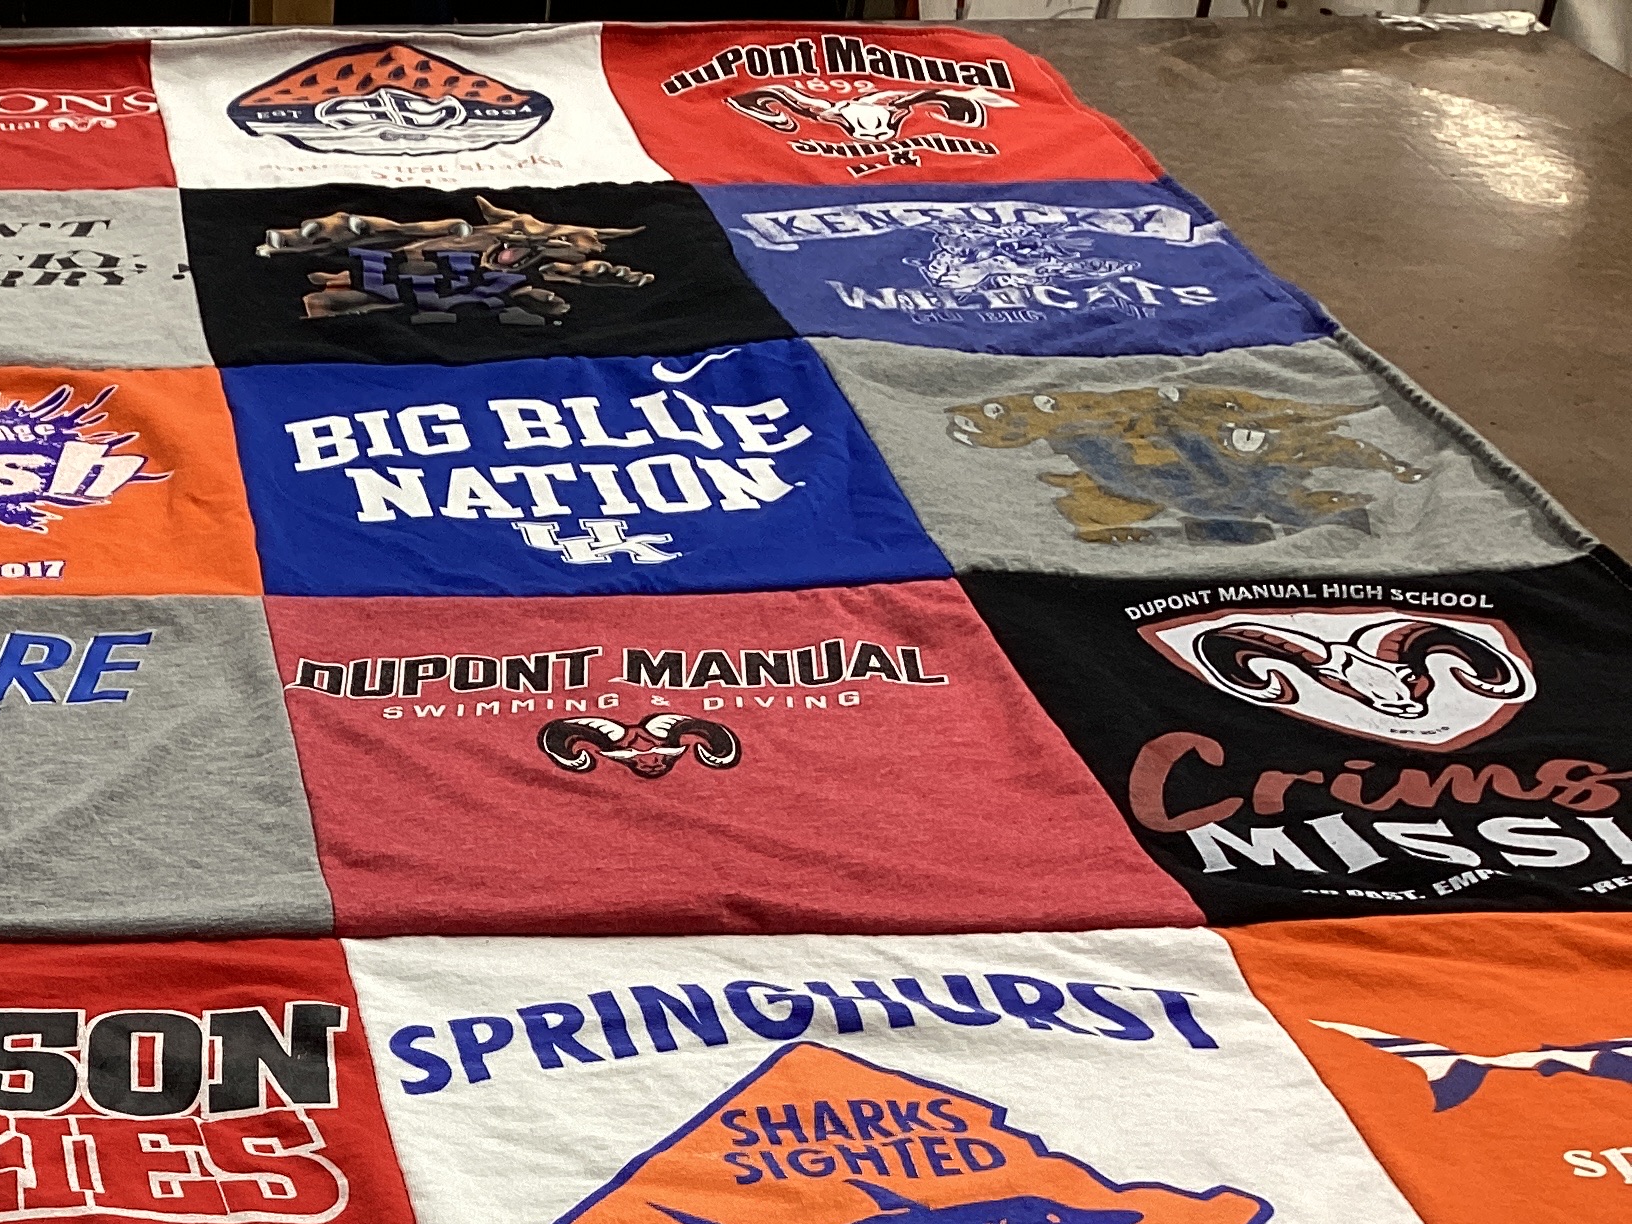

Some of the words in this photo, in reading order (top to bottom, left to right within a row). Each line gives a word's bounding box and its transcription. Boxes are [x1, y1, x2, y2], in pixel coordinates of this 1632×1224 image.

[793, 77, 876, 94] 1892
[821, 34, 1016, 92] Manual
[284, 402, 470, 472] BIG
[488, 388, 813, 454] BLUE
[344, 453, 795, 523] NATION
[1124, 589, 1213, 621] DUPONT
[1219, 582, 1317, 603] MANUAL
[1323, 582, 1383, 601] HIGH
[1389, 587, 1495, 609] SCHOOL
[614, 638, 949, 692] MANUAL
[382, 692, 620, 721] SWIMMING
[651, 693, 670, 707] &
[702, 691, 861, 711] DIVING
[388, 973, 1222, 1096] SPRINGHURST
[721, 1097, 970, 1148] SHARKS
[723, 1136, 1007, 1186] SIGHTED
